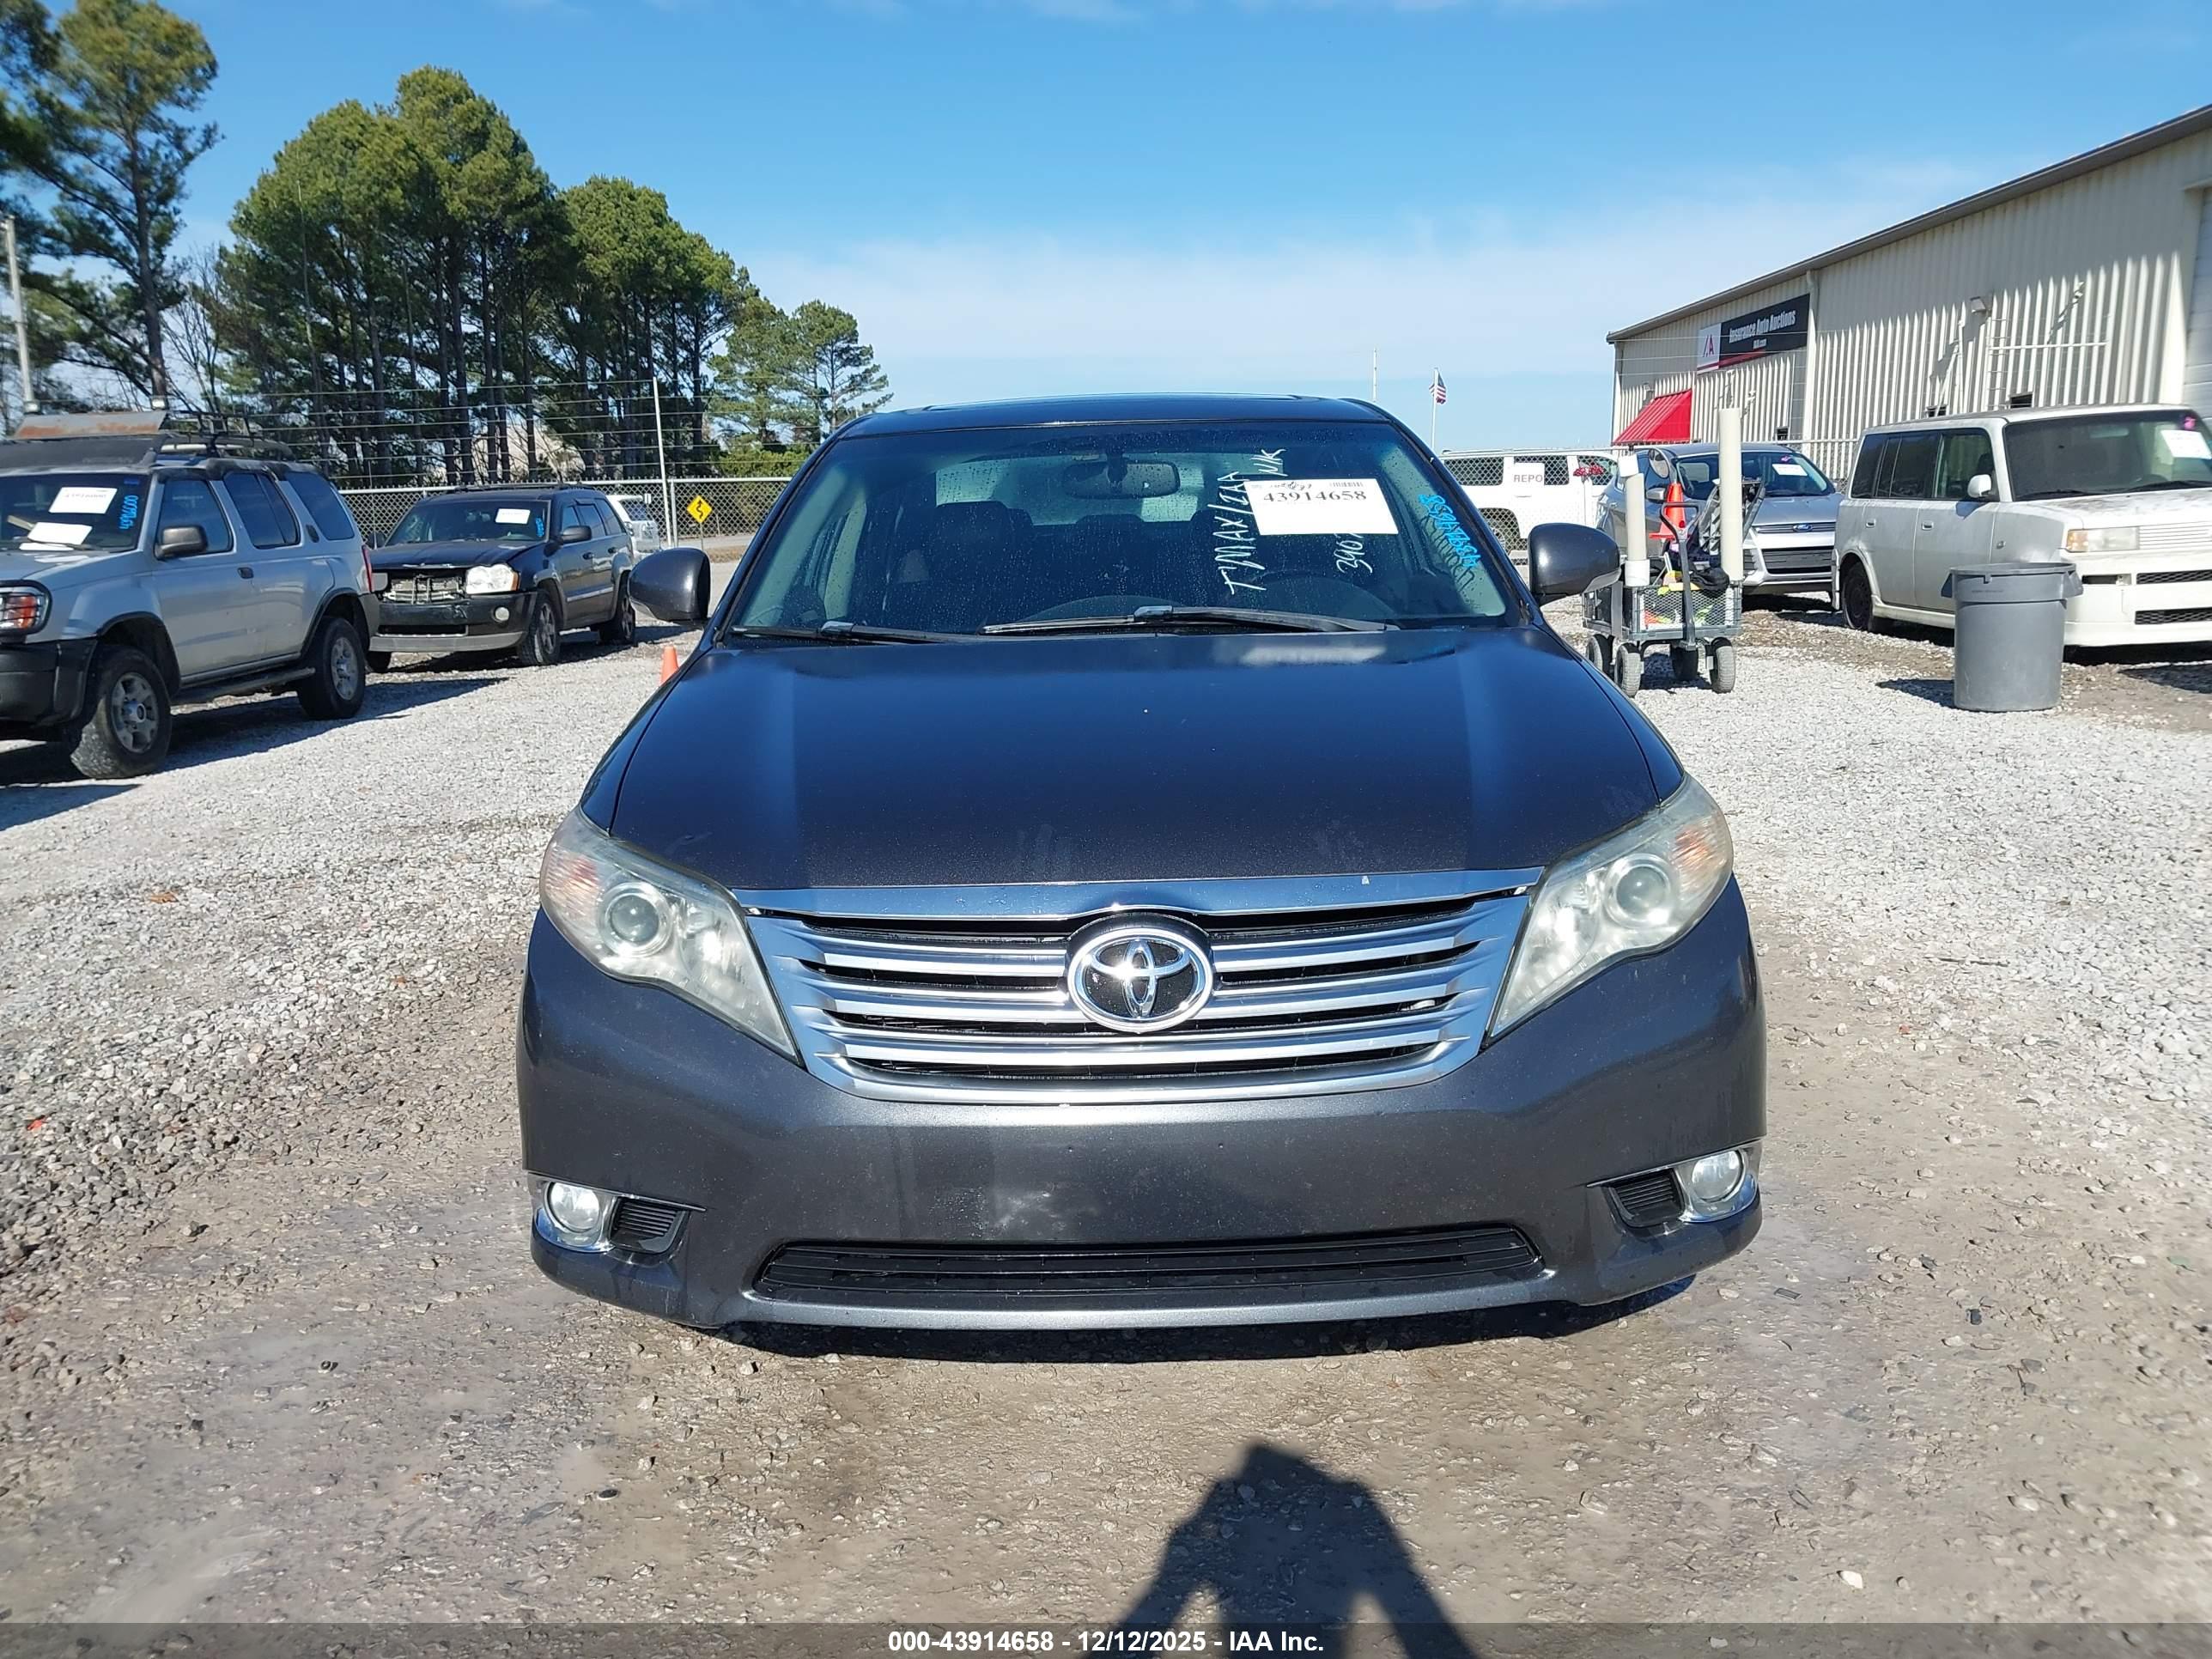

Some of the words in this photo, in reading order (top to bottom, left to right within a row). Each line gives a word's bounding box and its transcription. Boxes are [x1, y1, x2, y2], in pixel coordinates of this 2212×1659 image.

[1729, 323, 1756, 343] Insurance
[1756, 318, 1769, 335] Auto
[1769, 310, 1796, 331] Auctions
[1513, 474, 1543, 483] REPO
[1263, 490, 1367, 502] 43914658
